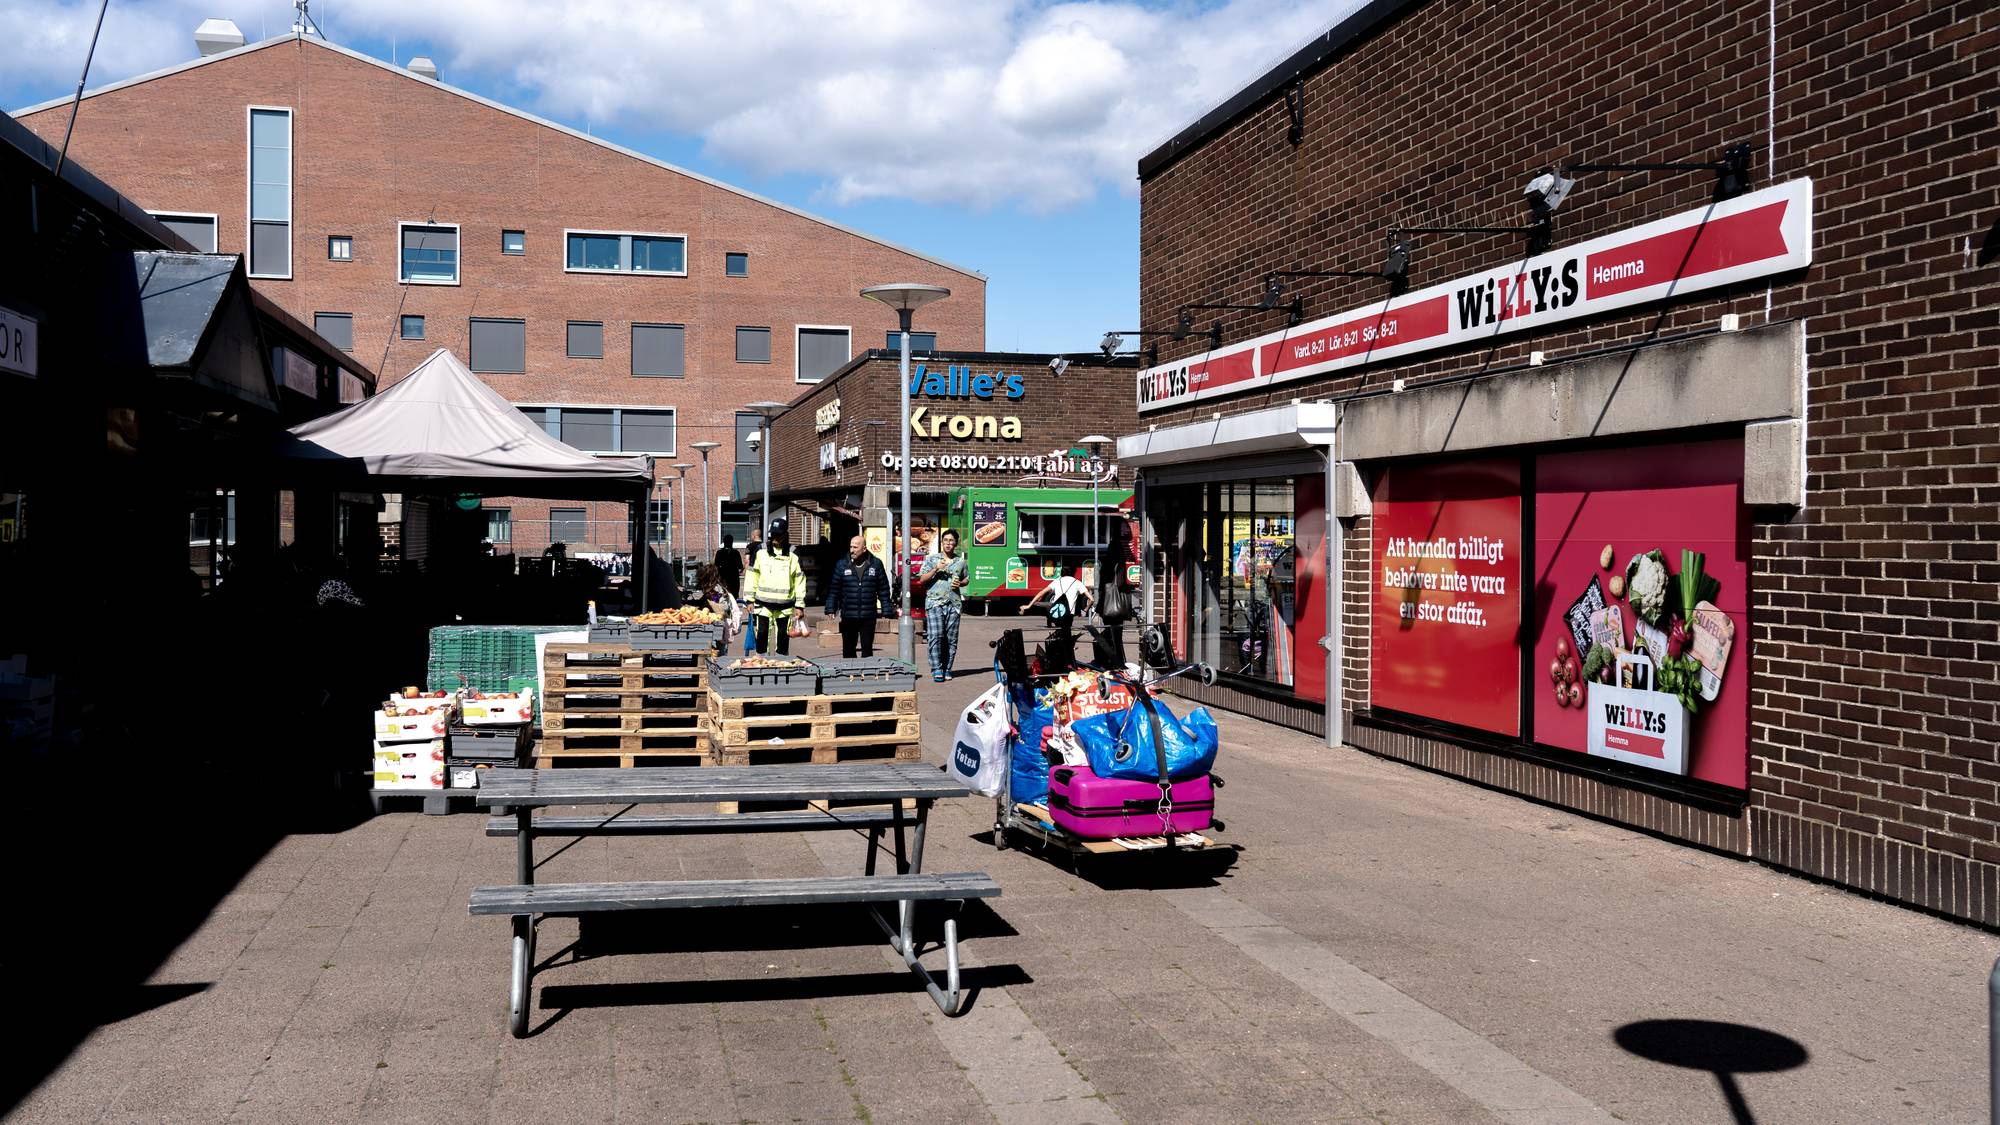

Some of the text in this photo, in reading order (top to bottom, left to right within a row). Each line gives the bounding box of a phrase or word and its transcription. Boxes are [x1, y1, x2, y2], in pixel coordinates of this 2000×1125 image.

[1457, 258, 1645, 330] WiLLY:S Hemma
[1294, 344, 1311, 359] Vard.
[1311, 339, 1325, 354] 8-21
[1329, 335, 1343, 351] Lör.
[1344, 330, 1359, 347] 8-21
[1381, 320, 1397, 337] 8-21
[900, 364, 1025, 398] Valle's
[1140, 366, 1209, 404] WiLLY:S Hemma
[910, 406, 1022, 439] Krona
[1386, 536, 1504, 565] Att handla billigt
[1385, 566, 1505, 595] behöver inte vara
[1400, 600, 1487, 627] en stor affär.
[1605, 703, 1666, 734] WiLLY:S
[1607, 734, 1629, 746] Hemma
